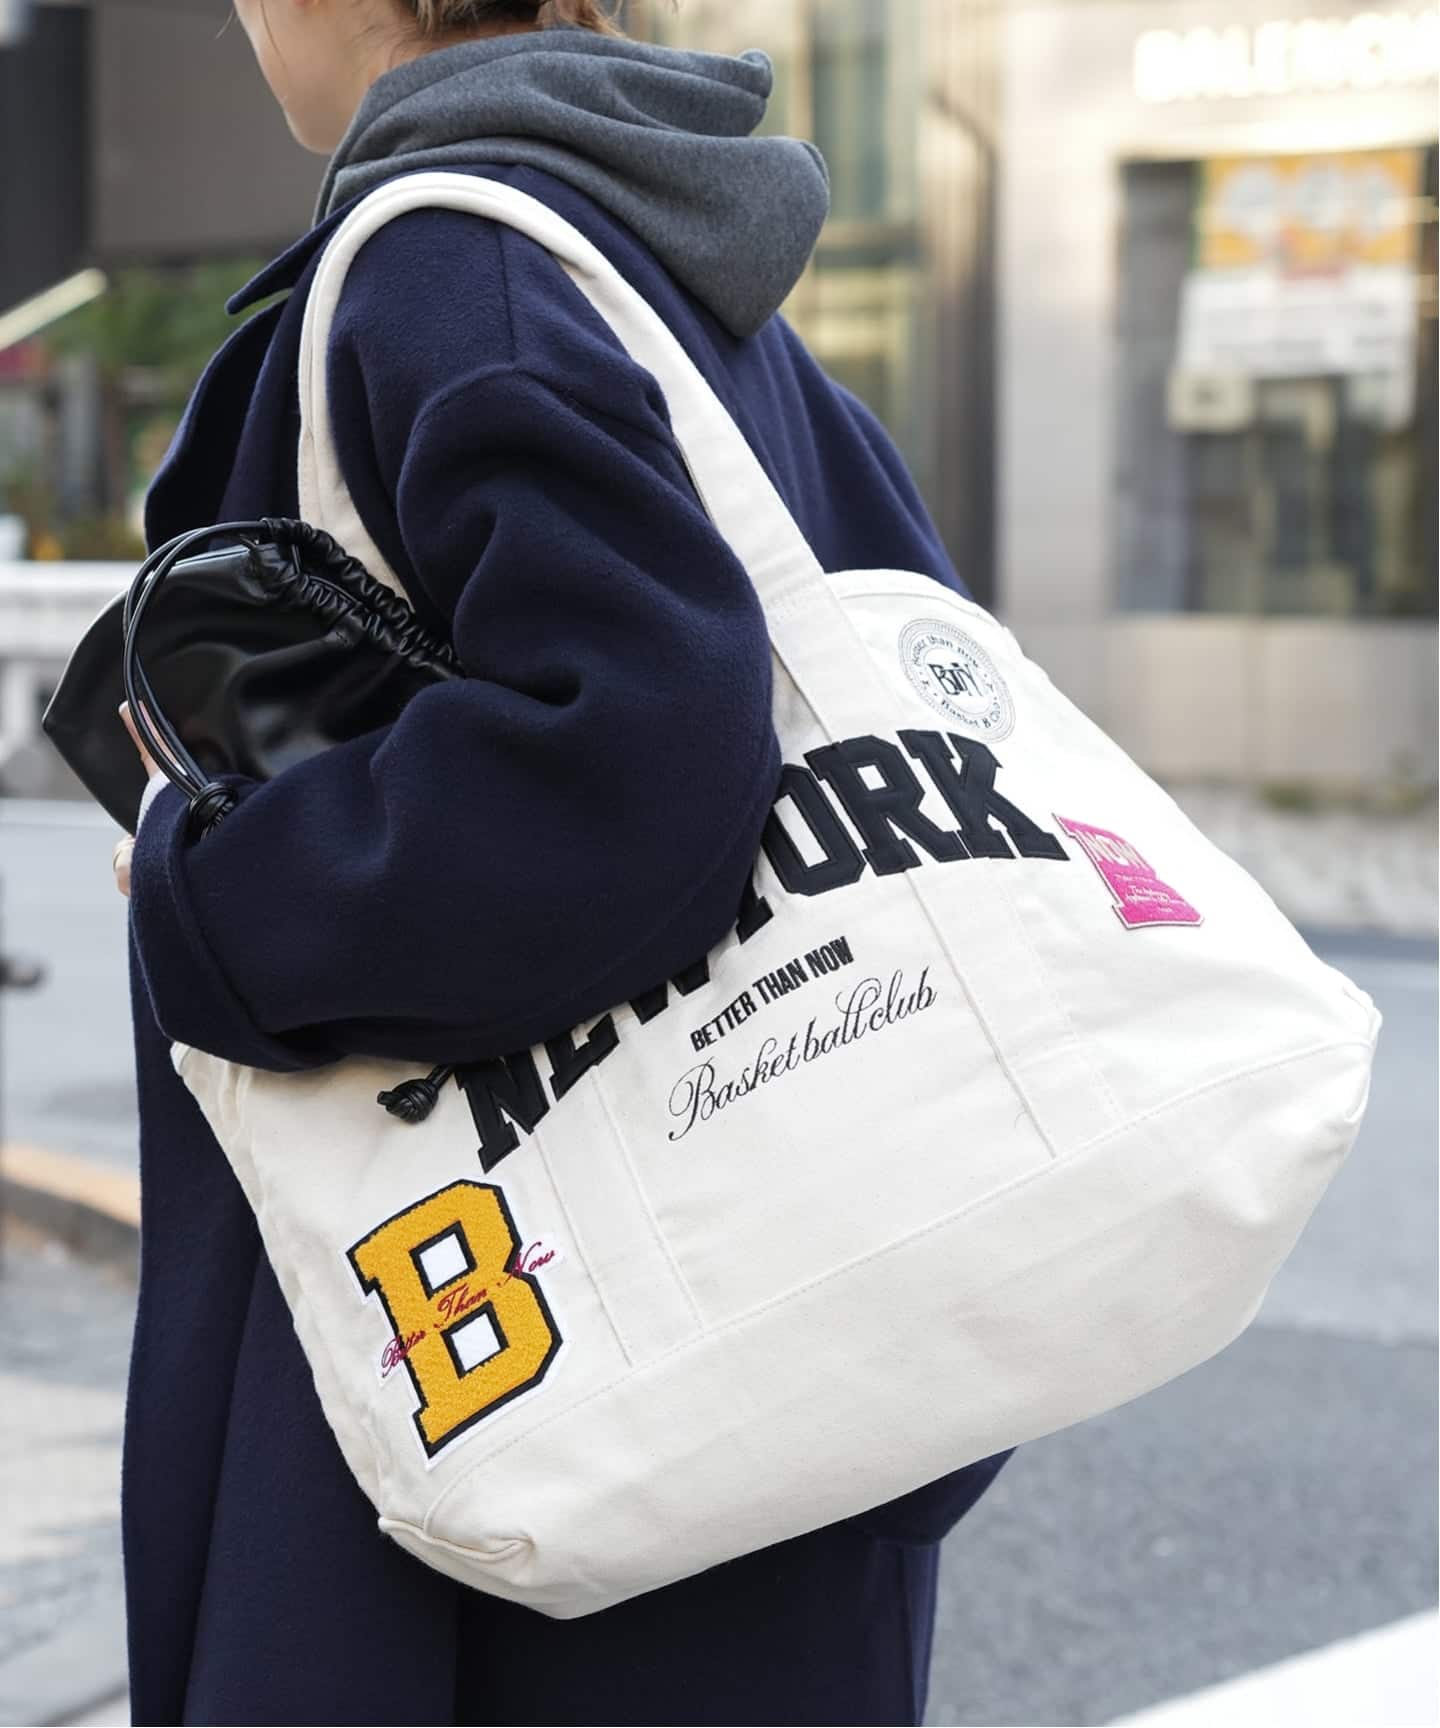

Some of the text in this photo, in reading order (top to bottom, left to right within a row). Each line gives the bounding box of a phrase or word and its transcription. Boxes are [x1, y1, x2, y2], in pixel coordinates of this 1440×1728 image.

[736, 729, 1071, 945] ORK
[690, 935, 855, 1052] BETTER THAN NOW
[346, 1180, 564, 1459] B
[433, 1282, 488, 1328] Than
[496, 1241, 556, 1288] Now
